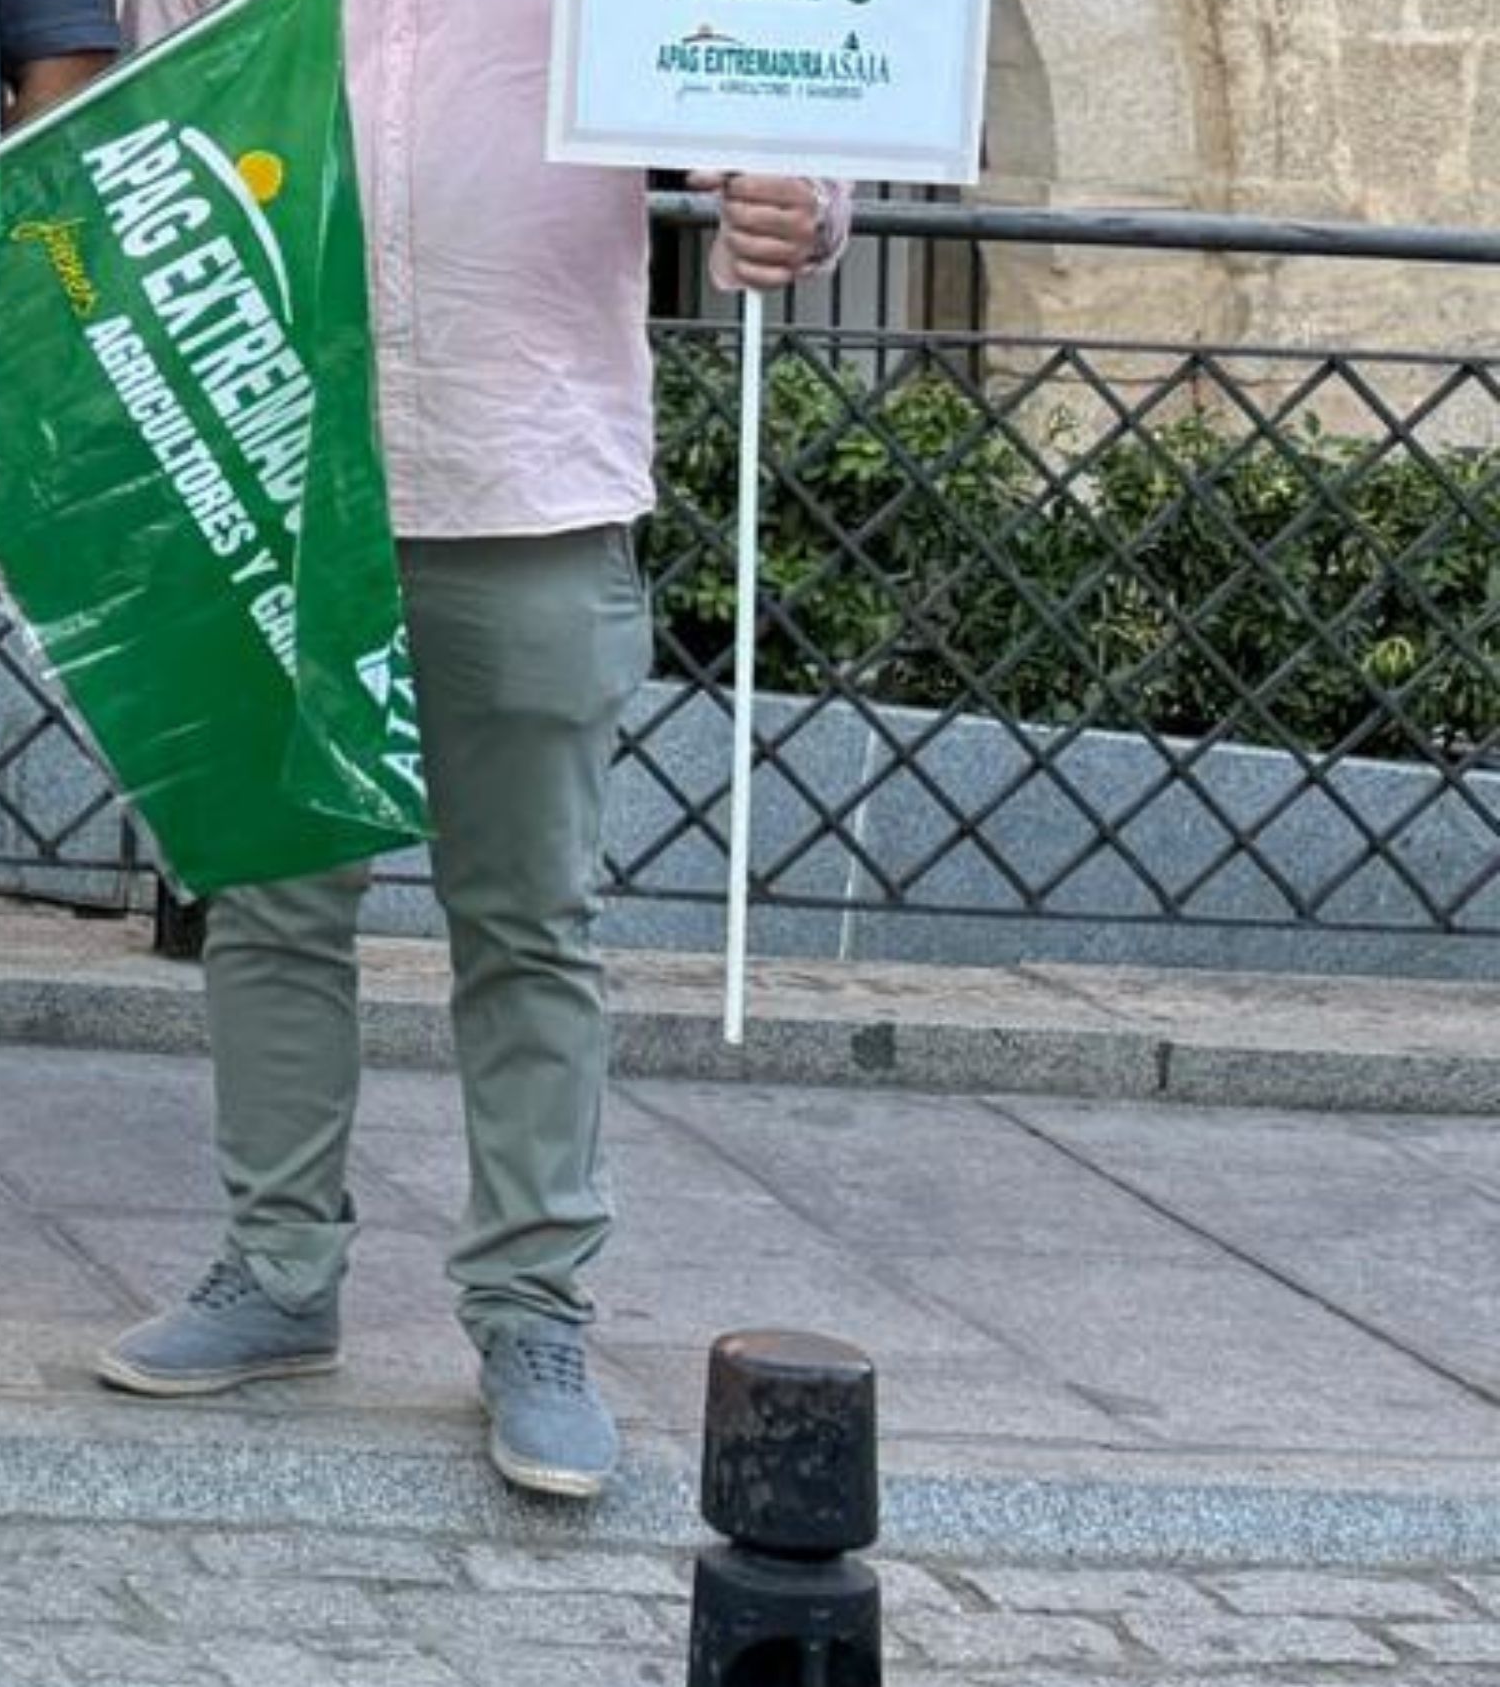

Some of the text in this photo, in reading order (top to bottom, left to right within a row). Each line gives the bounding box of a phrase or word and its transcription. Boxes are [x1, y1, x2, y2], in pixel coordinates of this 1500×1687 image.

[656, 44, 890, 86] APAG EXTREMADURA ASAJA
[83, 120, 315, 533] APAG EXTREMAD
[85, 315, 256, 556] AGRICULTORES
[232, 548, 277, 584] Y
